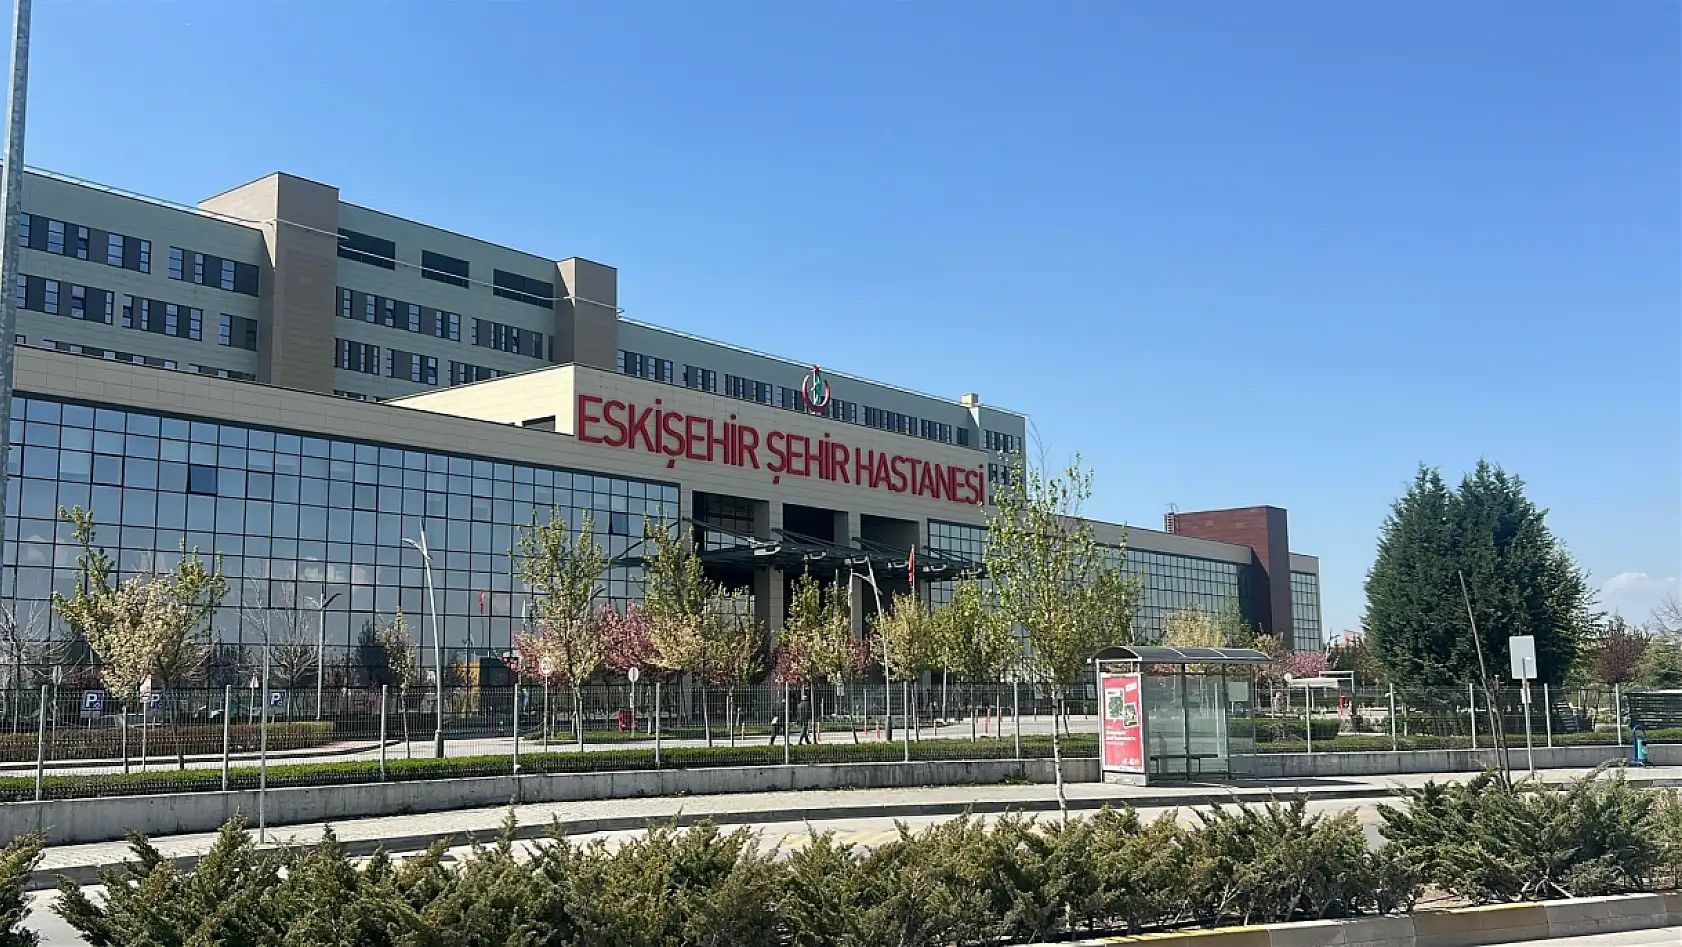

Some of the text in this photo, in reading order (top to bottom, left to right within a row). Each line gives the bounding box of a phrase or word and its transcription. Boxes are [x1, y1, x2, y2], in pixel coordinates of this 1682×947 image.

[577, 394, 985, 505] ESKİŞEHİR ŞEHİR HASTANESİ
[85, 693, 98, 708] P
[270, 692, 280, 704] P
